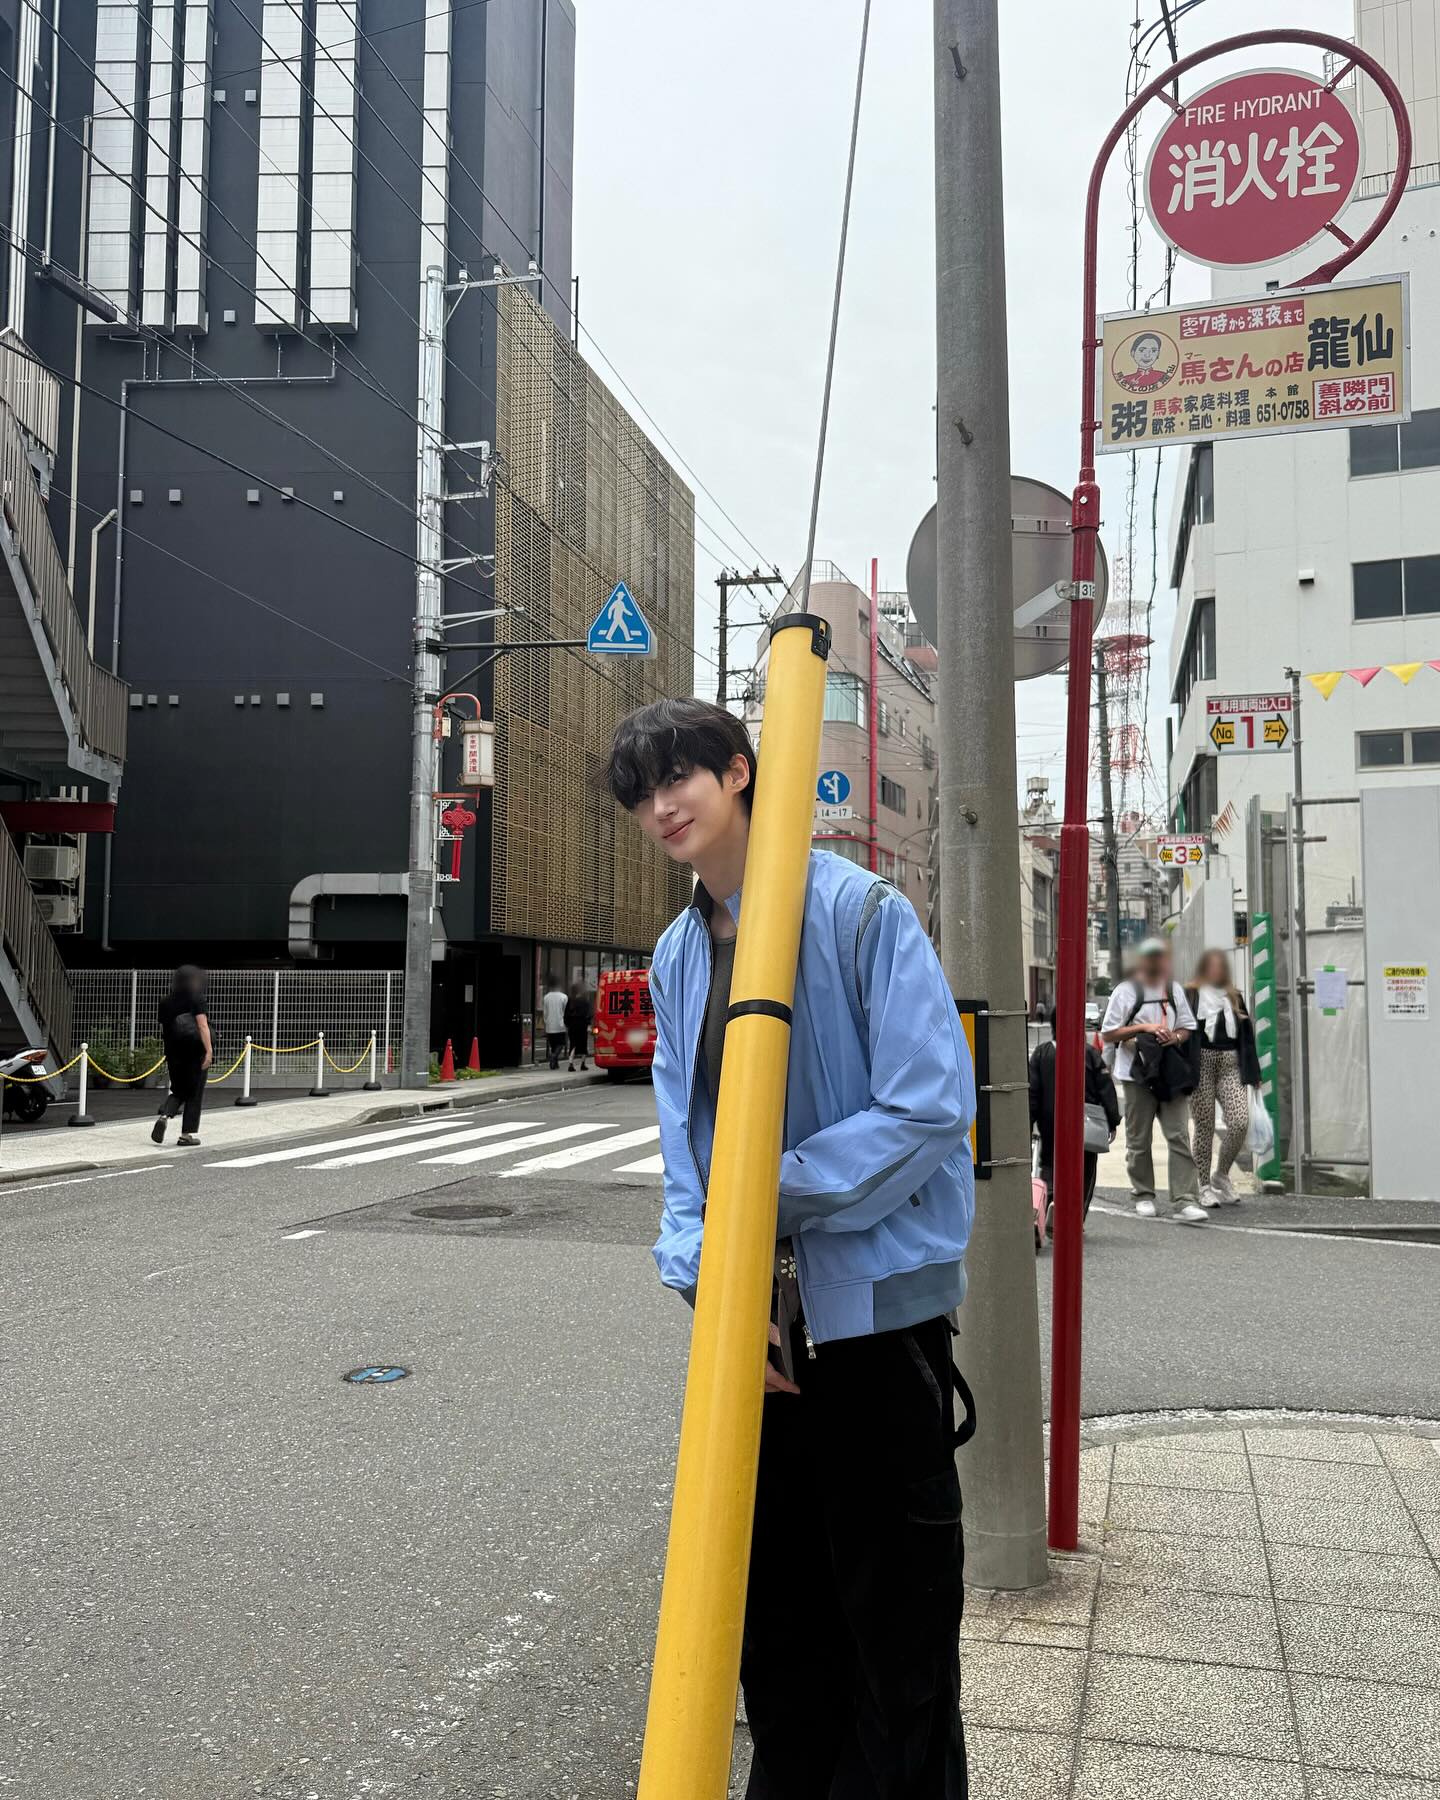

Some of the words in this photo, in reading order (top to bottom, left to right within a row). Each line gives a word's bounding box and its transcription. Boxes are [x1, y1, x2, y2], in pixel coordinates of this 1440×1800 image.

[1184, 103, 1226, 128] FIRE
[1233, 88, 1324, 121] HYDRANT
[1166, 121, 1344, 215] 消火栓
[1307, 312, 1394, 372] 龍仙
[1184, 352, 1202, 360] マー
[1178, 351, 1305, 386] 馬さんの店
[1264, 384, 1300, 398] 本館
[1318, 376, 1390, 399] 善隣門
[1152, 389, 1250, 417] 馬家家庭料理
[1256, 399, 1310, 423] 651-0758
[1318, 394, 1391, 416] 斜め前
[1111, 399, 1148, 441] 粥
[1209, 697, 1289, 714] 工事用車両出入口
[1216, 727, 1234, 740] No.
[1240, 716, 1254, 749] 1
[1264, 724, 1285, 738] ゲート
[821, 808, 847, 818] 14-17
[1175, 846, 1187, 865] 3
